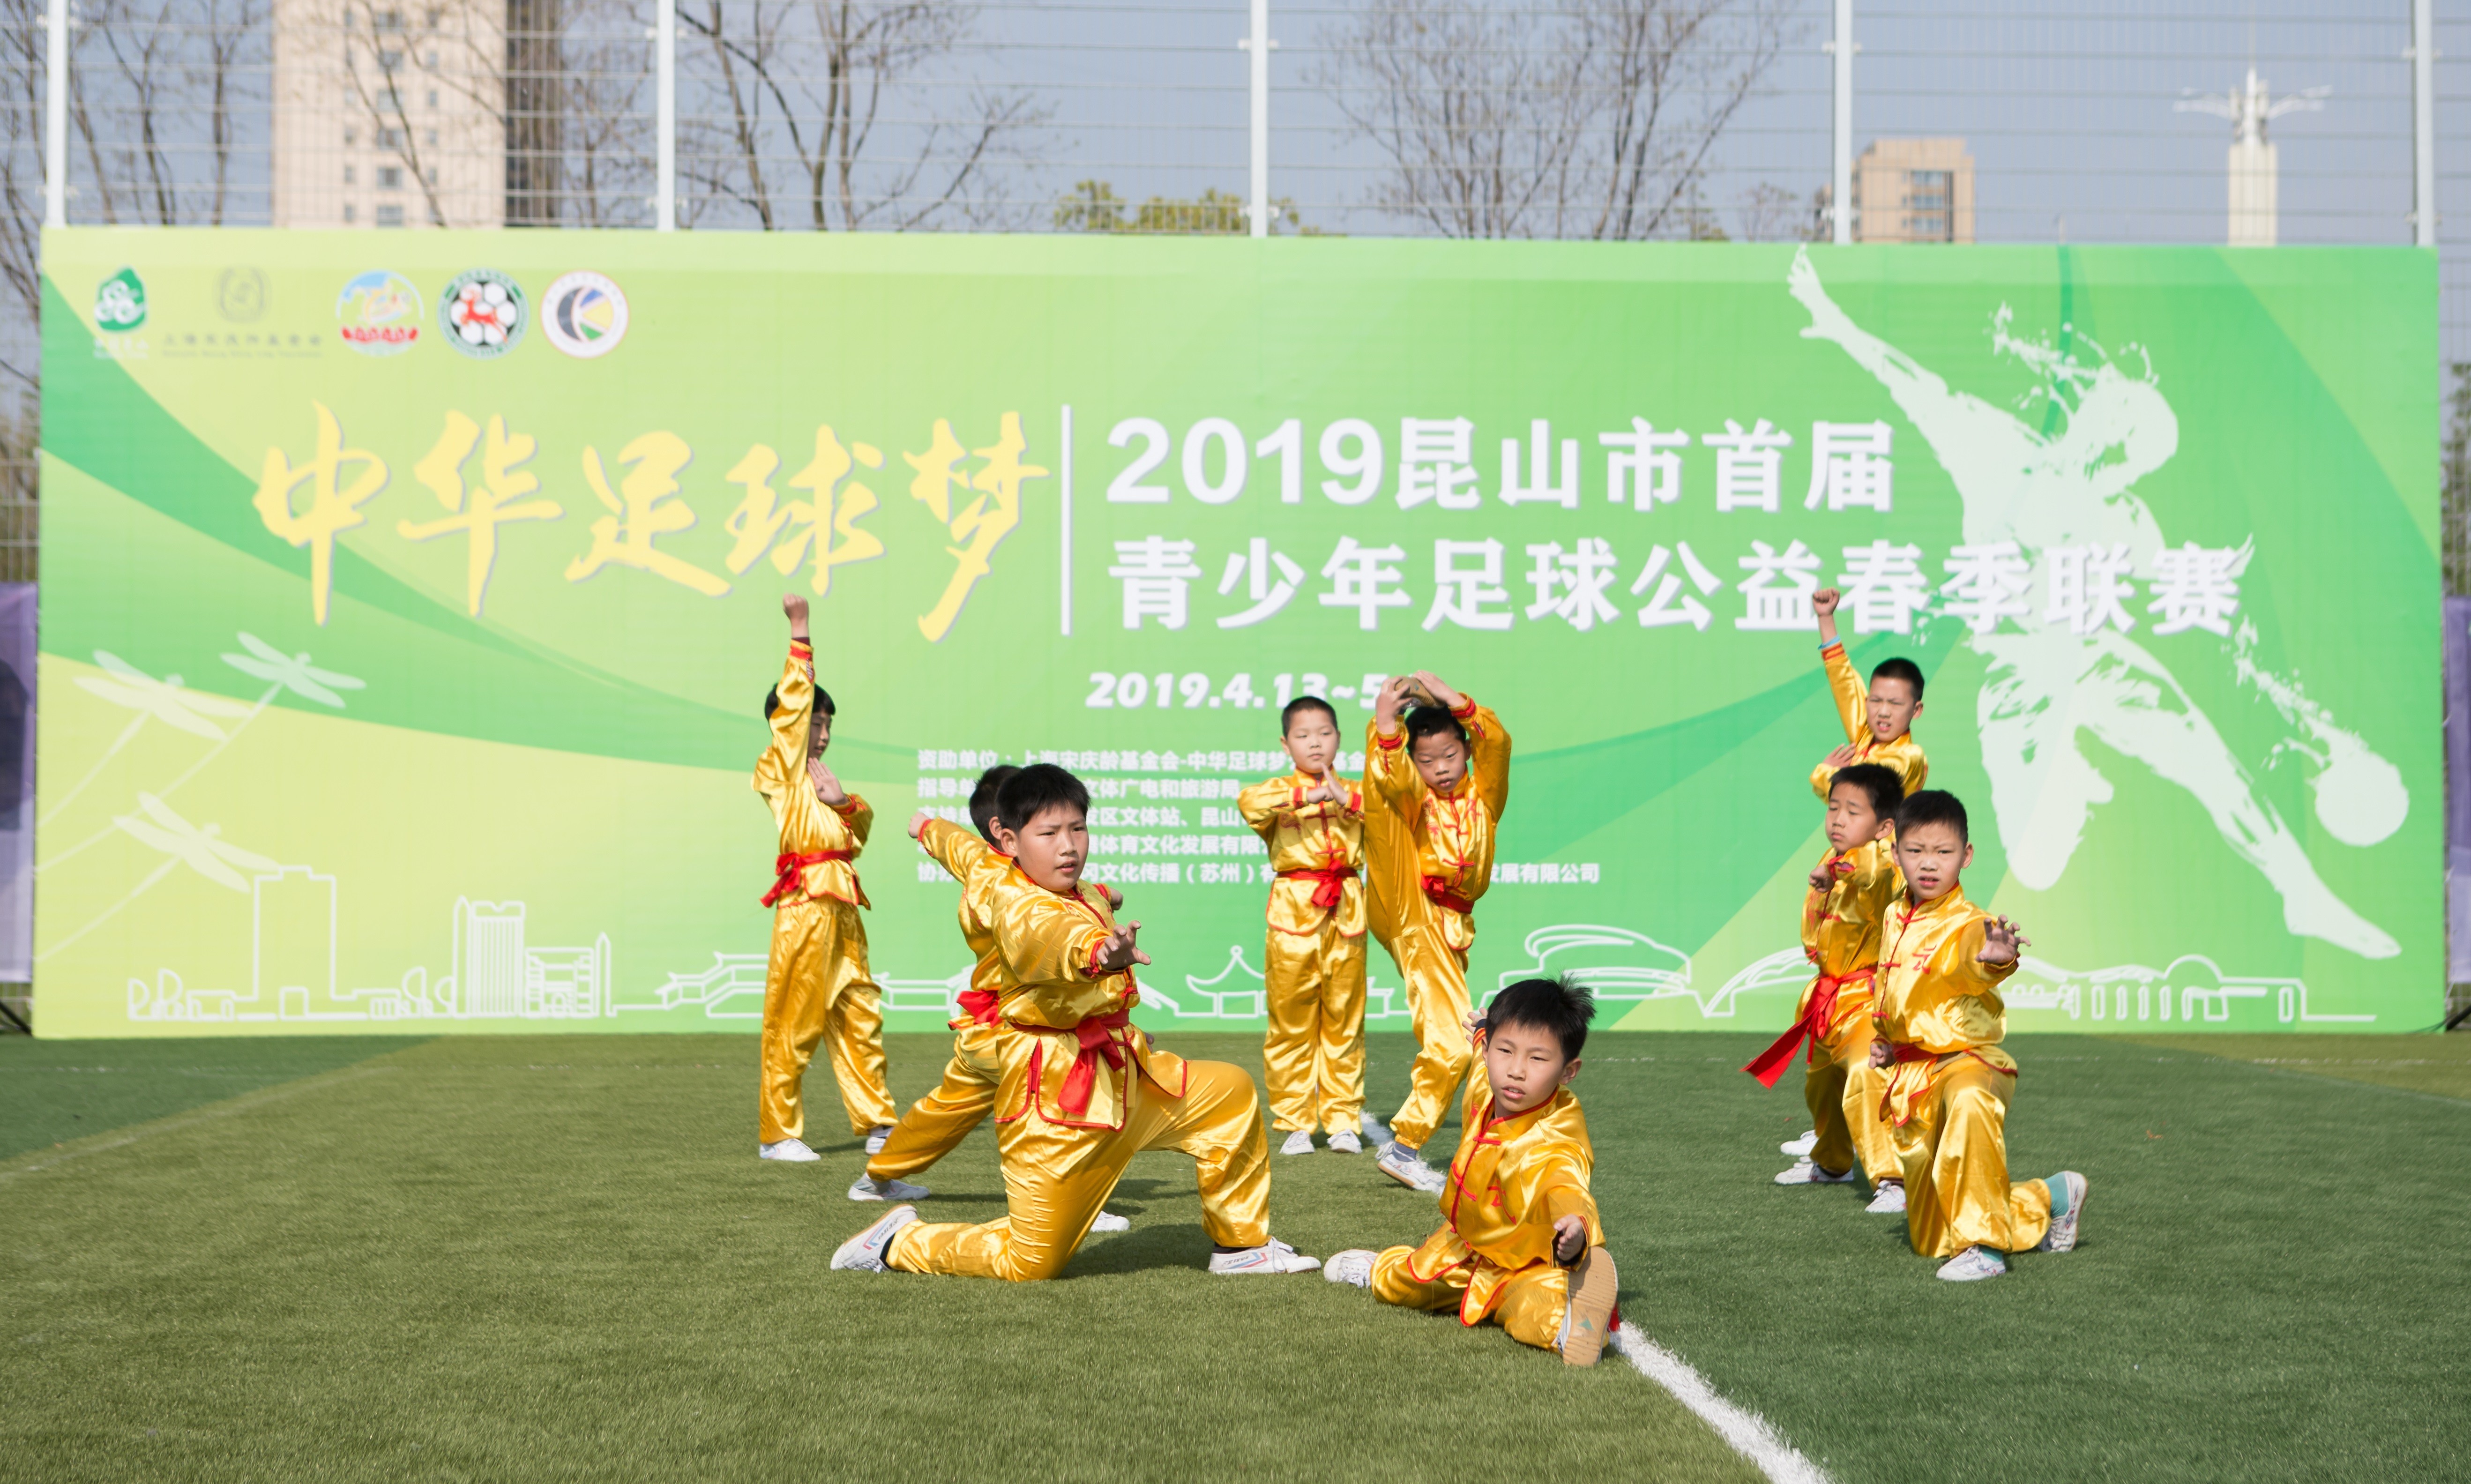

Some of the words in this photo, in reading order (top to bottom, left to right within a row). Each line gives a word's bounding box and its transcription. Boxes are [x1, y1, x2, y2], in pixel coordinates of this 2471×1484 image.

[1106, 416, 1893, 513] 2019昆山市首届
[252, 401, 1051, 643] 中华足球梦
[1107, 535, 2241, 637] 青少年足球公益春季联赛
